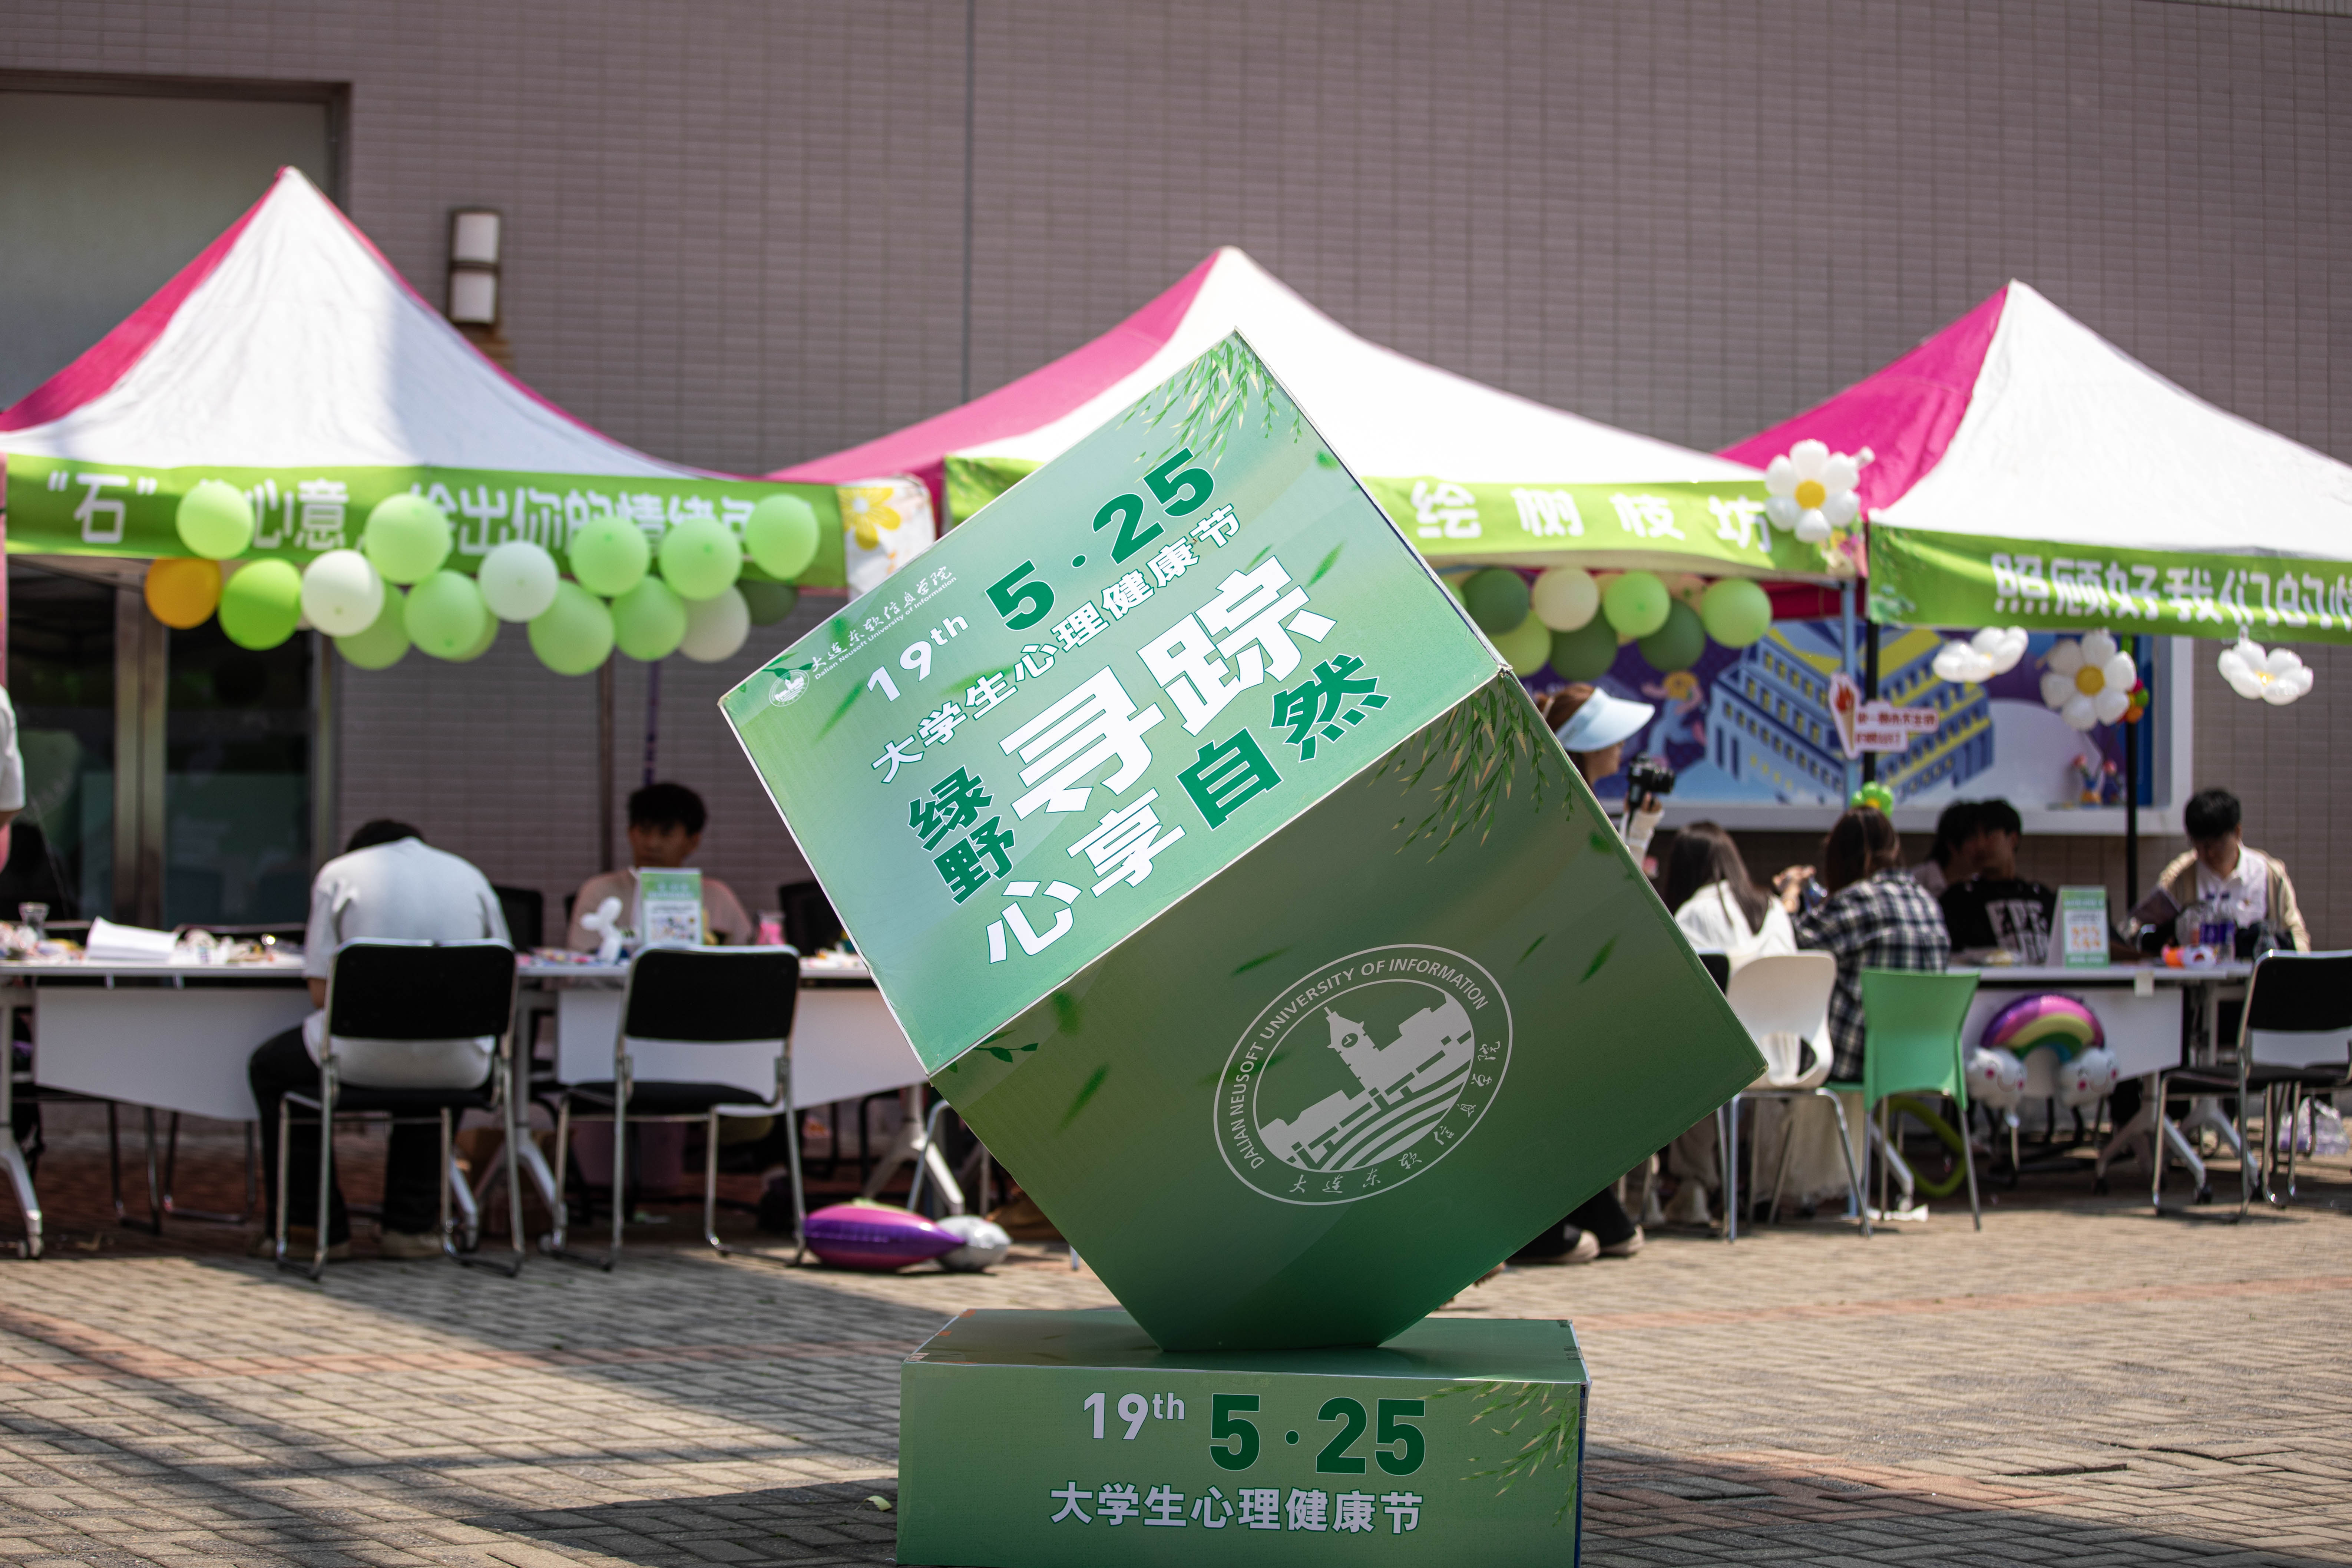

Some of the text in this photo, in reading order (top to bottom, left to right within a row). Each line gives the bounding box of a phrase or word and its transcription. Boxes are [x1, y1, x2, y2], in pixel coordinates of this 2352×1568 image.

[812, 566, 953, 672] 大连东软信息学院
[814, 576, 957, 680] Dalian Neusoft University of Information
[866, 615, 969, 702] 19th
[870, 503, 1241, 784] 大学生心理健康节
[907, 555, 1338, 906] 绿野 寻踪
[1230, 957, 1489, 1170] DALIAN NEUSOFT UNIVERSITY OF INFORMATION
[1082, 1391, 1186, 1442] 19th
[1049, 1480, 1423, 1535] 大学生心理健康节
